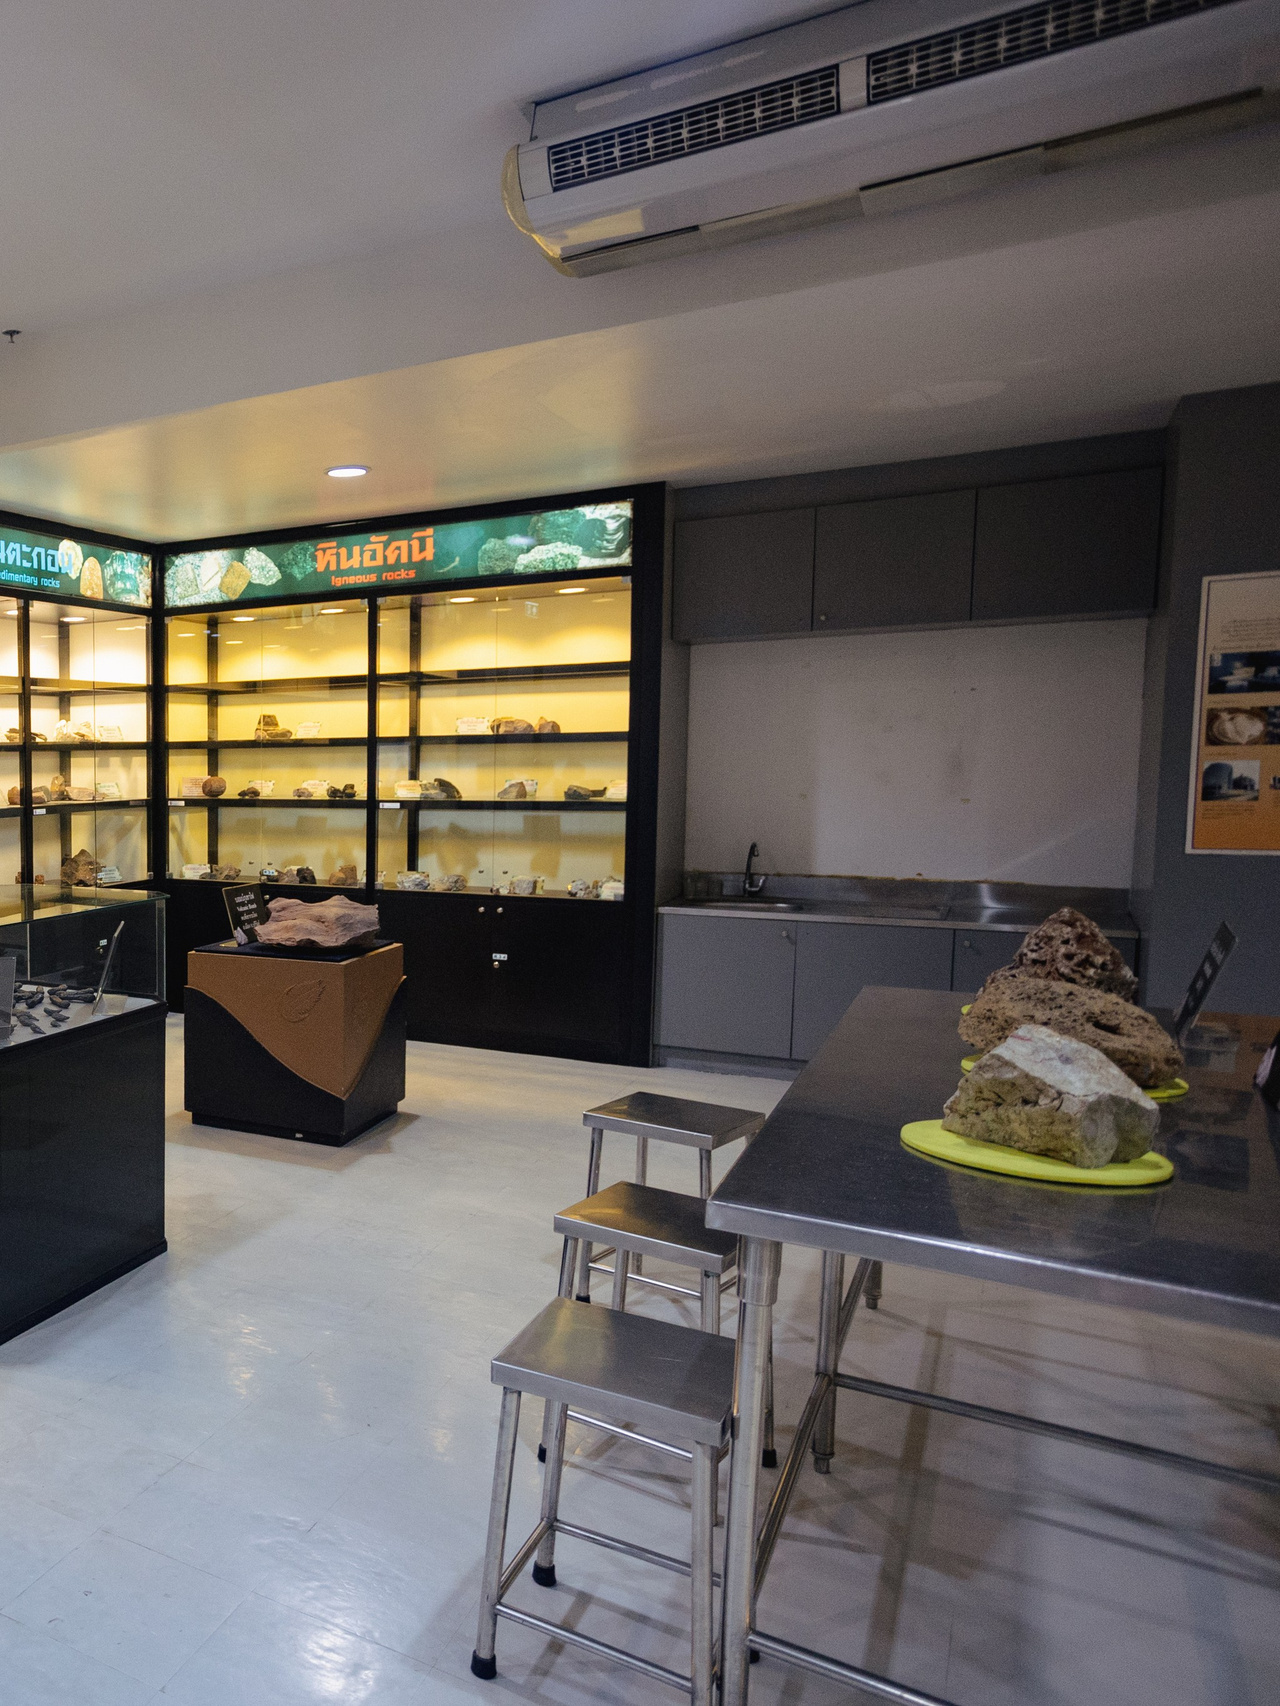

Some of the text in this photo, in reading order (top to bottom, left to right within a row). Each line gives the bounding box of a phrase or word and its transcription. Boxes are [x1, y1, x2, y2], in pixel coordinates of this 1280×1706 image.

[314, 527, 436, 573] หินอัคนี
[40, 576, 61, 589] rocks
[331, 568, 417, 588] Igneous rocks
